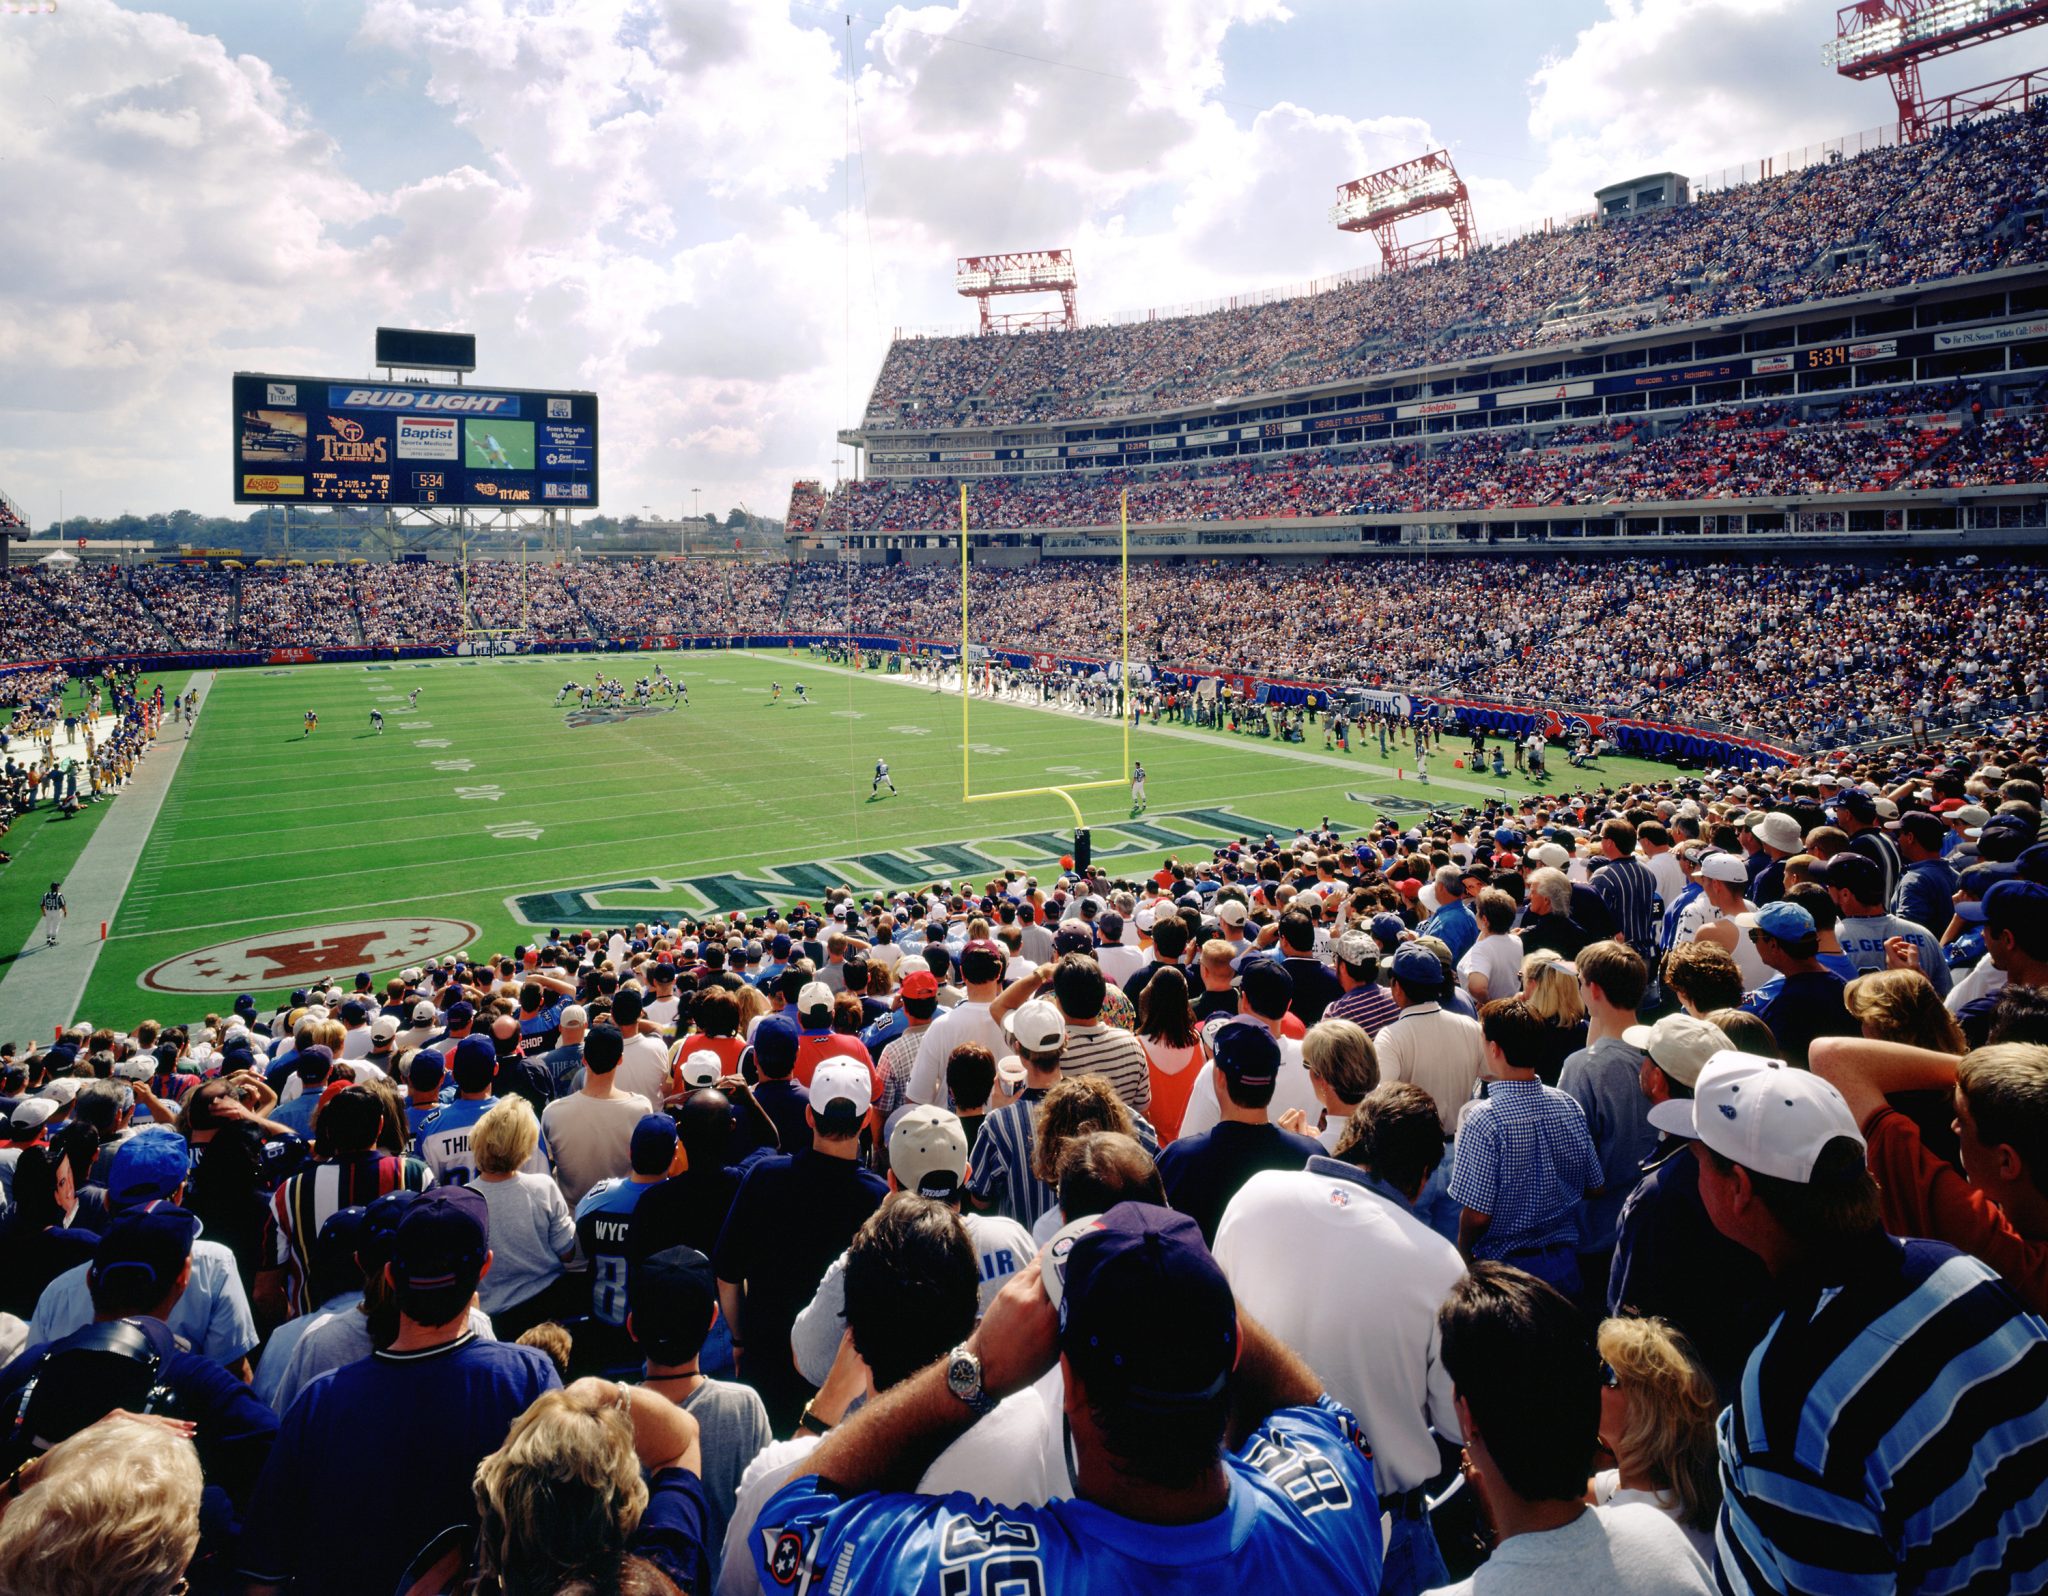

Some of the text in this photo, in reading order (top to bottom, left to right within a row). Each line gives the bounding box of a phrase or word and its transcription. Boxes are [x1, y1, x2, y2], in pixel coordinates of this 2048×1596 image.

[1809, 346, 1845, 368] 5:34
[343, 389, 507, 411] BUD LIGHT
[1556, 386, 1567, 399] A
[1419, 402, 1457, 414] Adelphia
[1265, 423, 1282, 436] 5:34
[1315, 418, 1342, 429] CHEVROLET
[401, 427, 453, 440] Baptist
[316, 434, 387, 463] TITANS
[319, 479, 389, 489] 7 0
[420, 474, 442, 487] 5:34
[427, 490, 435, 502] 6
[499, 489, 530, 500] TITANS
[484, 820, 545, 840] 10
[1860, 934, 1925, 952] GEGE
[245, 931, 388, 980] A
[442, 1135, 472, 1156] THI
[920, 1187, 951, 1198] TITANS
[595, 1220, 629, 1241] WYC
[978, 1249, 1015, 1283] IR
[593, 1254, 629, 1327] 8
